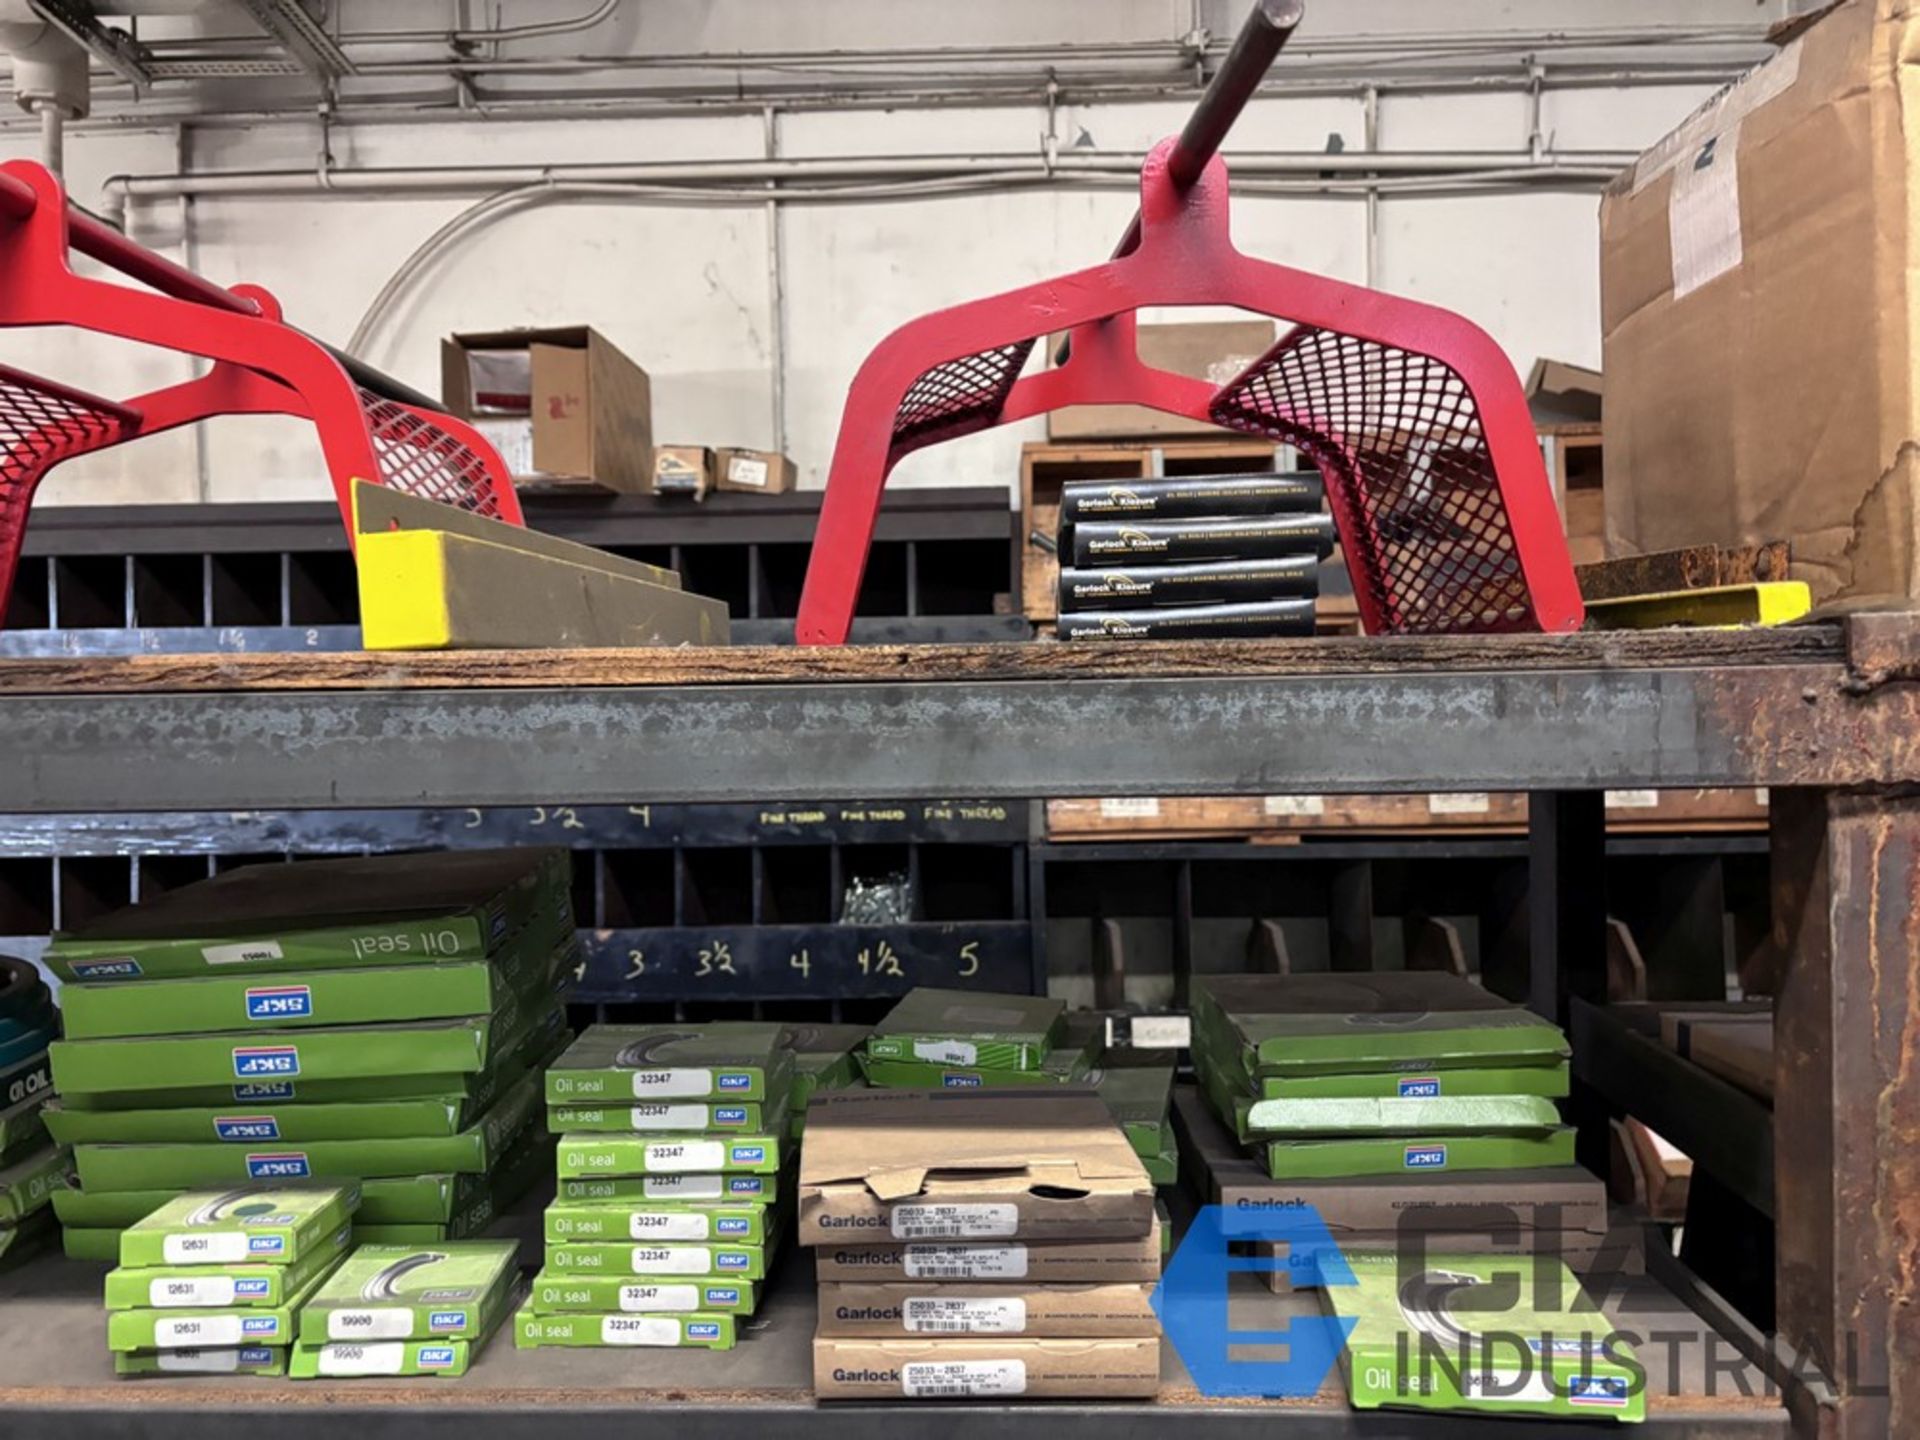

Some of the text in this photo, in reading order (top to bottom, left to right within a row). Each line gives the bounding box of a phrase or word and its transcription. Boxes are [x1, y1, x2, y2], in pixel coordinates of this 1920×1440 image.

[1077, 498, 1114, 509] Garlock
[1089, 539, 1125, 550] Garlock
[1073, 583, 1110, 594] Garlock
[305, 629, 318, 645] 2
[1070, 626, 1106, 637] Garlock
[924, 806, 1006, 821] FINE THREAD
[350, 933, 411, 960] seal
[425, 930, 461, 956] Oil
[624, 949, 645, 980] 3
[789, 952, 812, 977] 4
[957, 941, 980, 977] 5
[83, 962, 134, 976] SKF
[253, 997, 304, 1013] SKF
[240, 1057, 292, 1072] SKF
[640, 1073, 671, 1084] 32347
[720, 1077, 748, 1086] SKF
[555, 1079, 604, 1092] Oil seal
[1403, 1084, 1436, 1096] SKF
[557, 1108, 604, 1121] Oil seal
[717, 1111, 745, 1119] SKF
[224, 1124, 272, 1136] SKF
[653, 1147, 684, 1158] 32347
[734, 1149, 762, 1158] SKF
[1409, 1153, 1442, 1164] SKF
[567, 1153, 615, 1166] Oil seal
[254, 1162, 302, 1176] SKF
[567, 1184, 615, 1197] Oil seal
[732, 1180, 760, 1189] SKF
[1236, 1197, 1308, 1212] Garlock
[555, 1219, 603, 1232] Oil seal
[637, 1216, 669, 1227] 32347
[719, 1220, 747, 1229] SKF
[818, 1213, 889, 1229] Garlock
[252, 1239, 282, 1250] SKF
[555, 1252, 603, 1266] Oil seal
[639, 1250, 671, 1261] 32347
[719, 1254, 747, 1264] SKF
[834, 1251, 901, 1266] Garlock
[237, 1282, 267, 1292] SKF
[626, 1288, 658, 1298] 32347
[543, 1289, 591, 1303] Oil seal
[708, 1290, 737, 1299] SKF
[836, 1306, 903, 1321] Garlock
[245, 1320, 276, 1330] SKF
[433, 1315, 465, 1325] SKF
[609, 1320, 640, 1331] 32347
[525, 1323, 573, 1337] Oil seal
[690, 1325, 717, 1334] SKF
[422, 1351, 454, 1361] SKF
[833, 1367, 900, 1383] Garlock
[1364, 1368, 1439, 1393] Oil seal
